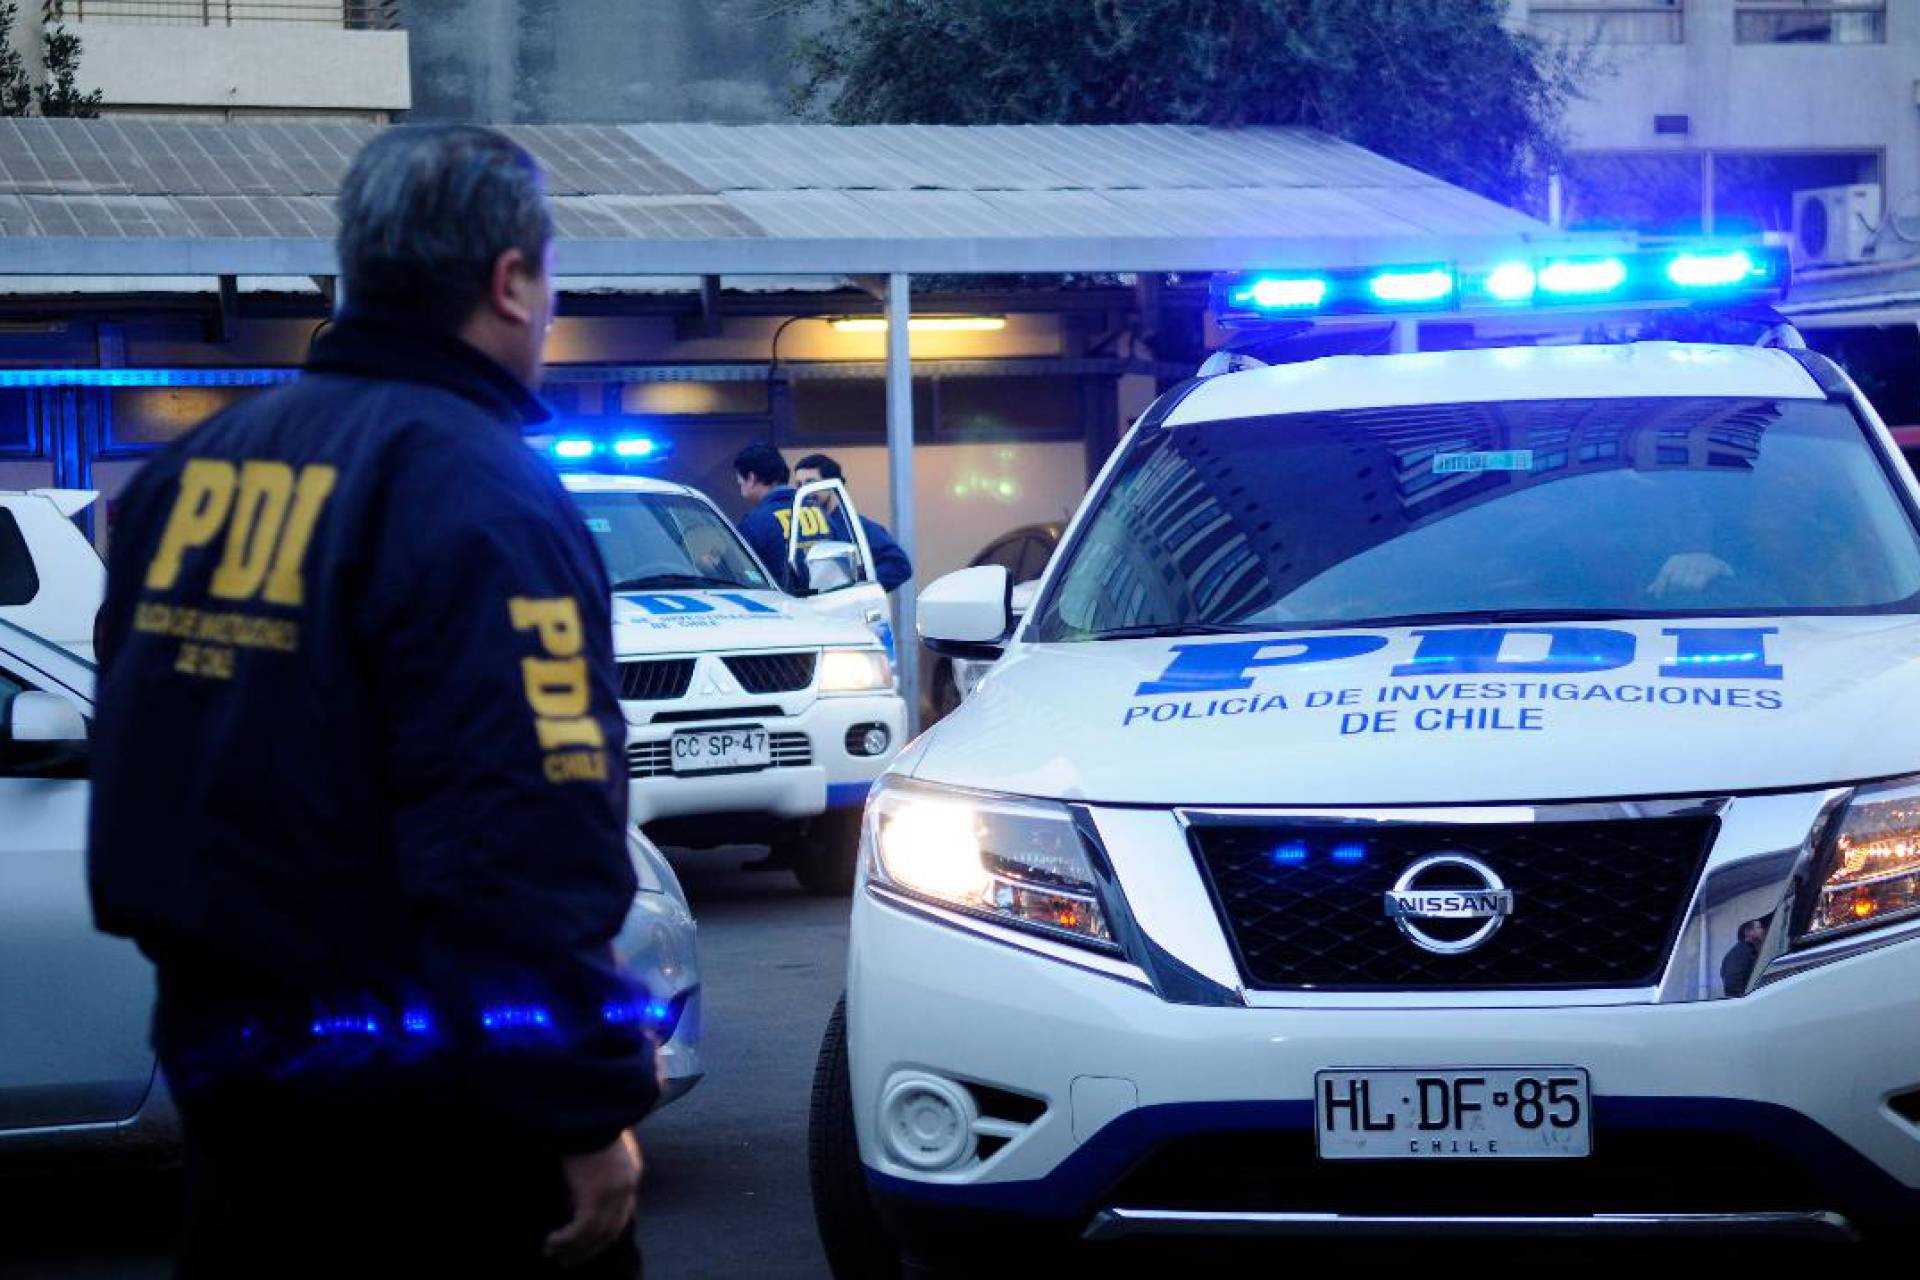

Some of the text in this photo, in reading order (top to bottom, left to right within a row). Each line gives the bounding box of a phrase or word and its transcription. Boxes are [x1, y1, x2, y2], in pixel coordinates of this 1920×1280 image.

[146, 459, 336, 604] PDI
[614, 594, 778, 615] DI
[509, 597, 605, 750] PDI
[1134, 626, 1783, 697] PDI
[1122, 682, 1783, 727] POLICÍA DE INVESTIGACIONES
[1340, 706, 1544, 736] DE CHILE
[1399, 896, 1498, 912] NISSAN
[1410, 1140, 1498, 1153] CHILE
